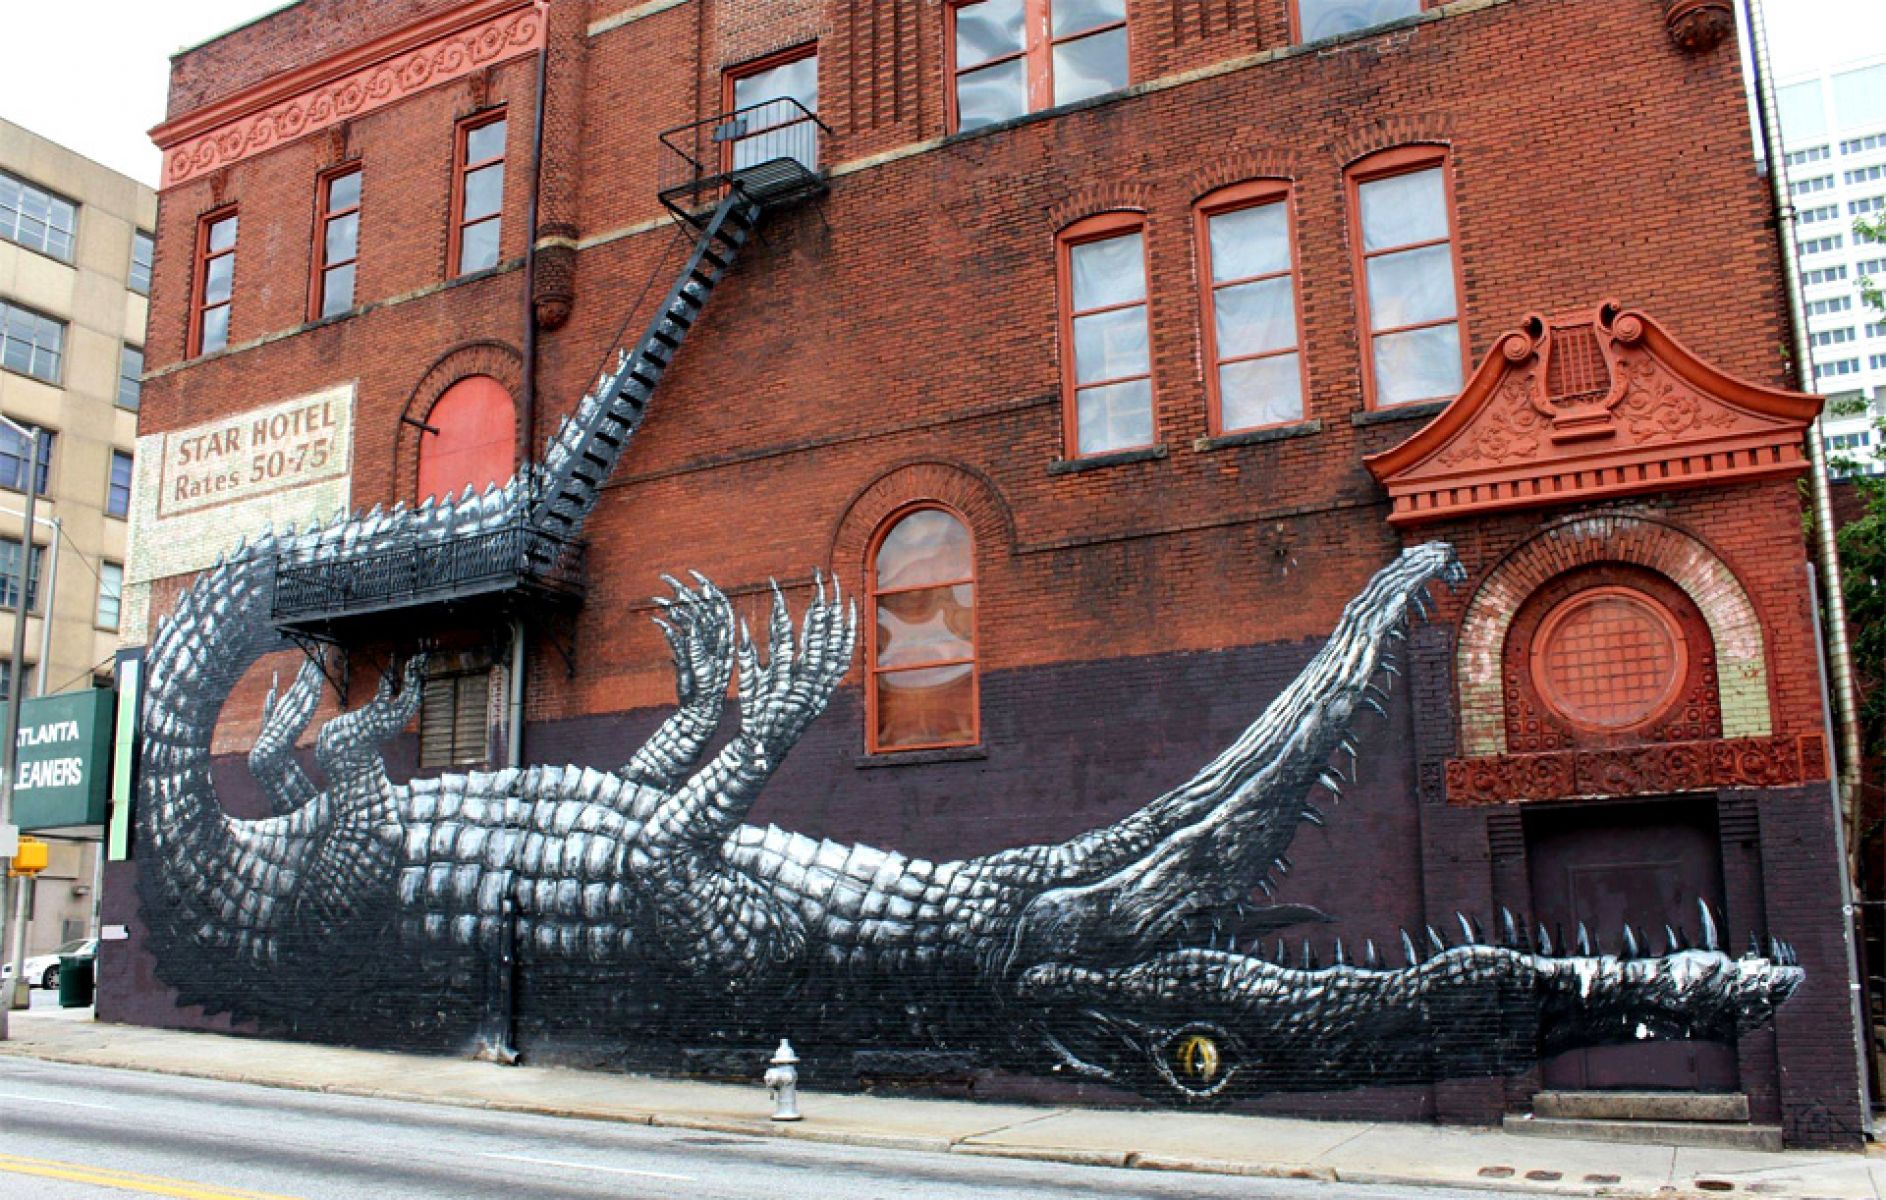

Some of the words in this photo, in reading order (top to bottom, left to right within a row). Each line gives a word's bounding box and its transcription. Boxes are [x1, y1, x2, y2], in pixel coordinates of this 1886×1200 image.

[178, 426, 240, 466] STAR
[252, 400, 336, 446] HOTEL
[174, 471, 240, 501] Rates
[16, 720, 80, 747] TLANTA
